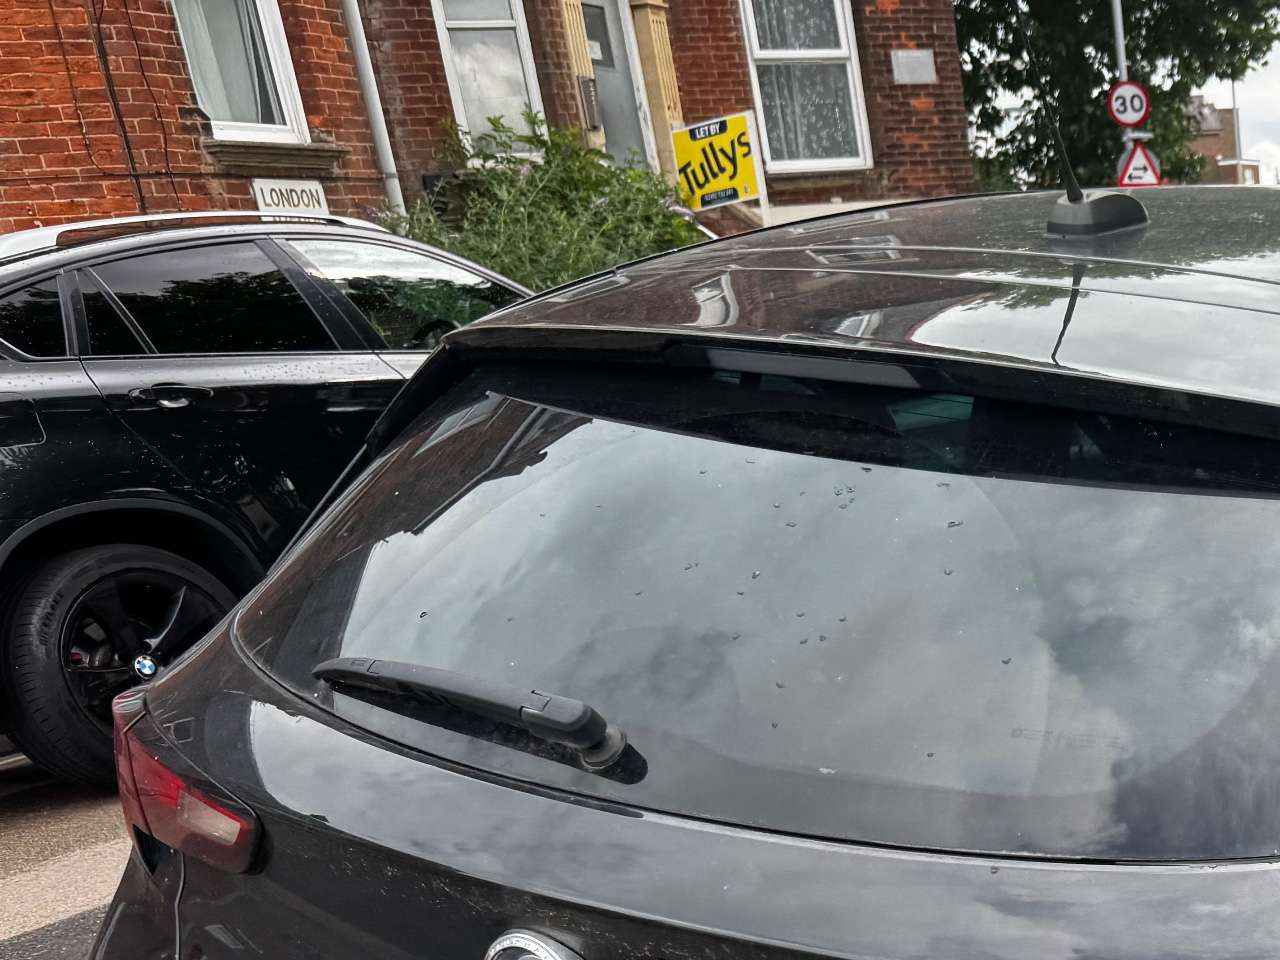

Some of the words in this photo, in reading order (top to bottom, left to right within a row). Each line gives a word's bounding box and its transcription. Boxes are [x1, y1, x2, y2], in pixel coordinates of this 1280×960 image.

[1115, 94, 1144, 114] 30
[695, 126, 709, 139] LET
[710, 123, 721, 136] BY
[679, 132, 752, 196] Tullys
[260, 187, 322, 208] LONDON
